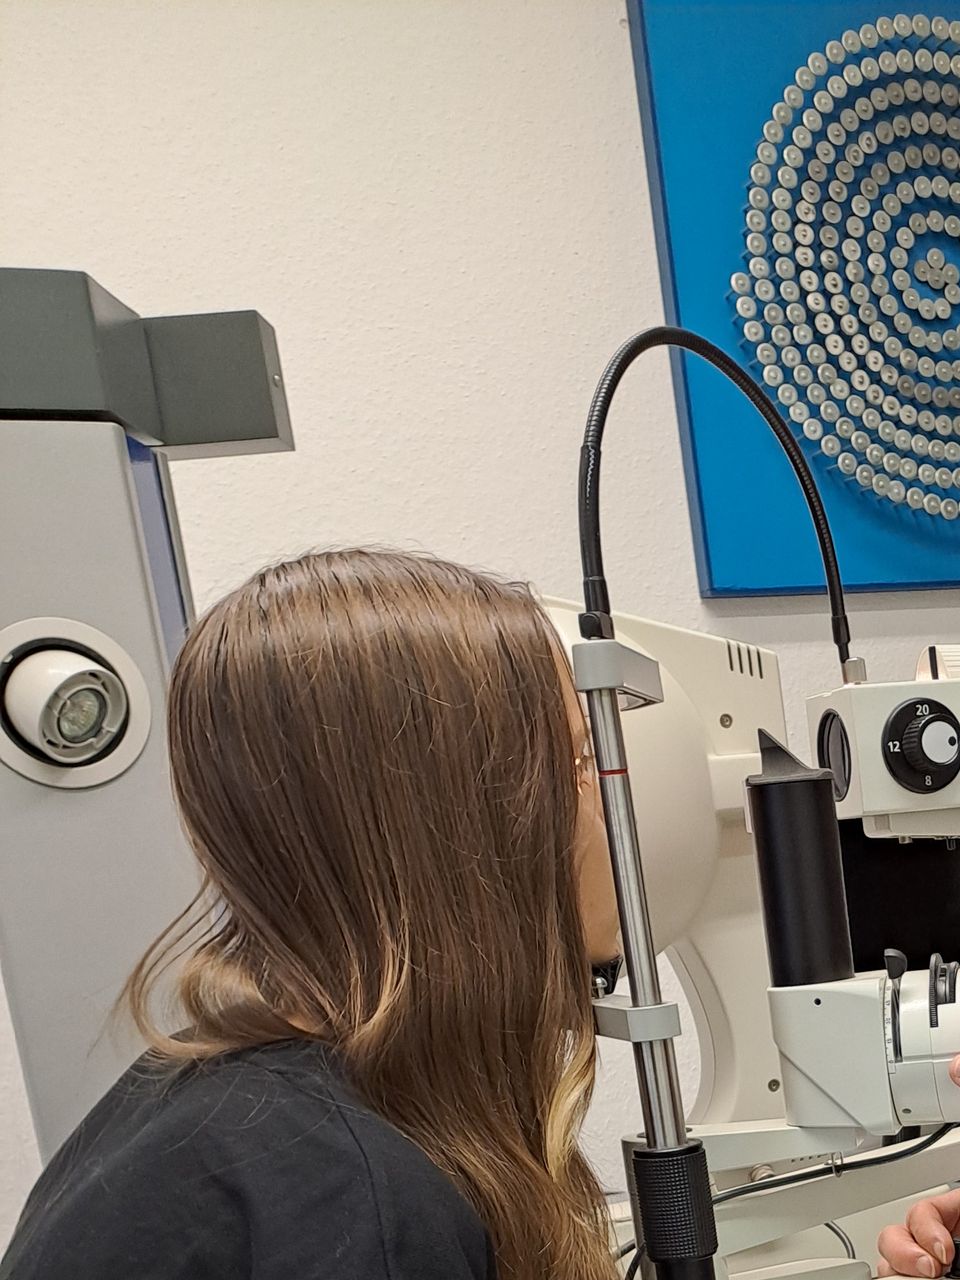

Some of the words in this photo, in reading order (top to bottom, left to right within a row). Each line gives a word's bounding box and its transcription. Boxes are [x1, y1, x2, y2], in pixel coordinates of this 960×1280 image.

[915, 704, 930, 716] 20
[887, 741, 902, 753] 12
[925, 775, 932, 786] 8
